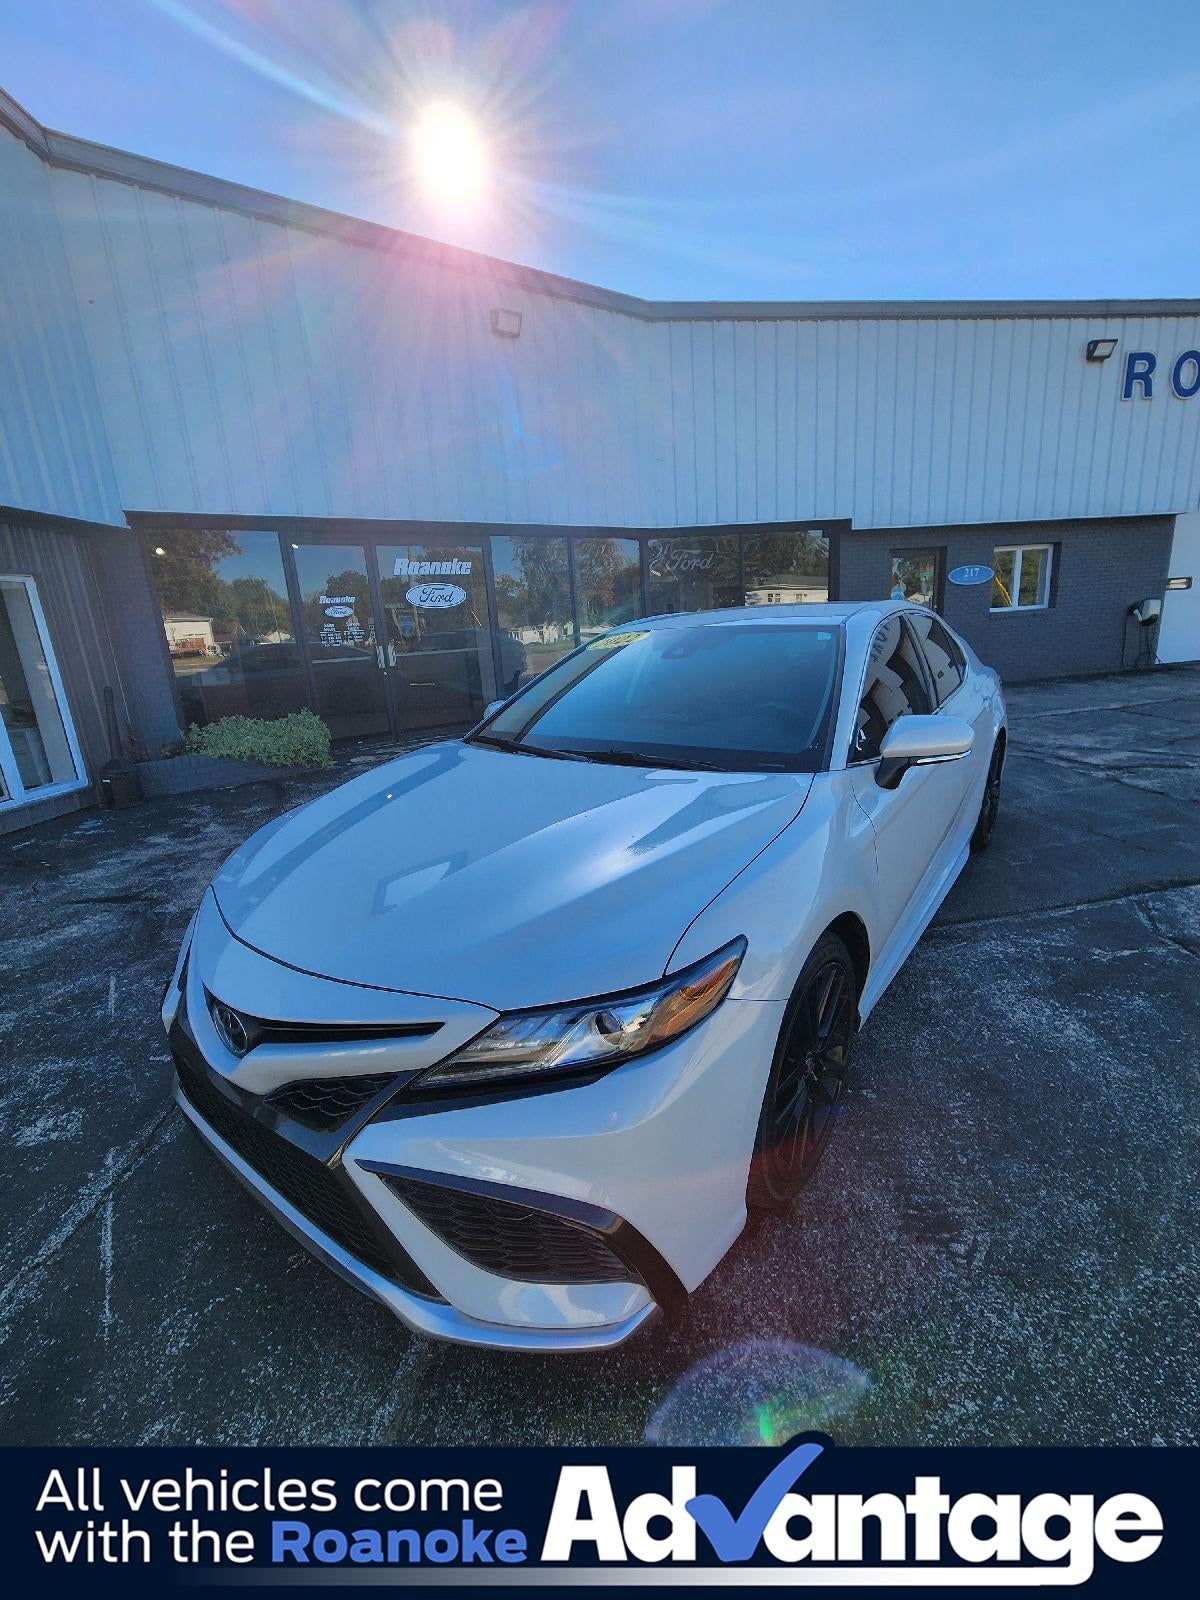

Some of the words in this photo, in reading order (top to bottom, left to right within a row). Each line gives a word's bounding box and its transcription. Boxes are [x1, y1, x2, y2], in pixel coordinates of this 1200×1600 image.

[393, 558, 472, 576] Roanoke
[666, 549, 715, 571] Ford
[964, 567, 980, 578] 217
[419, 587, 455, 603] Ford
